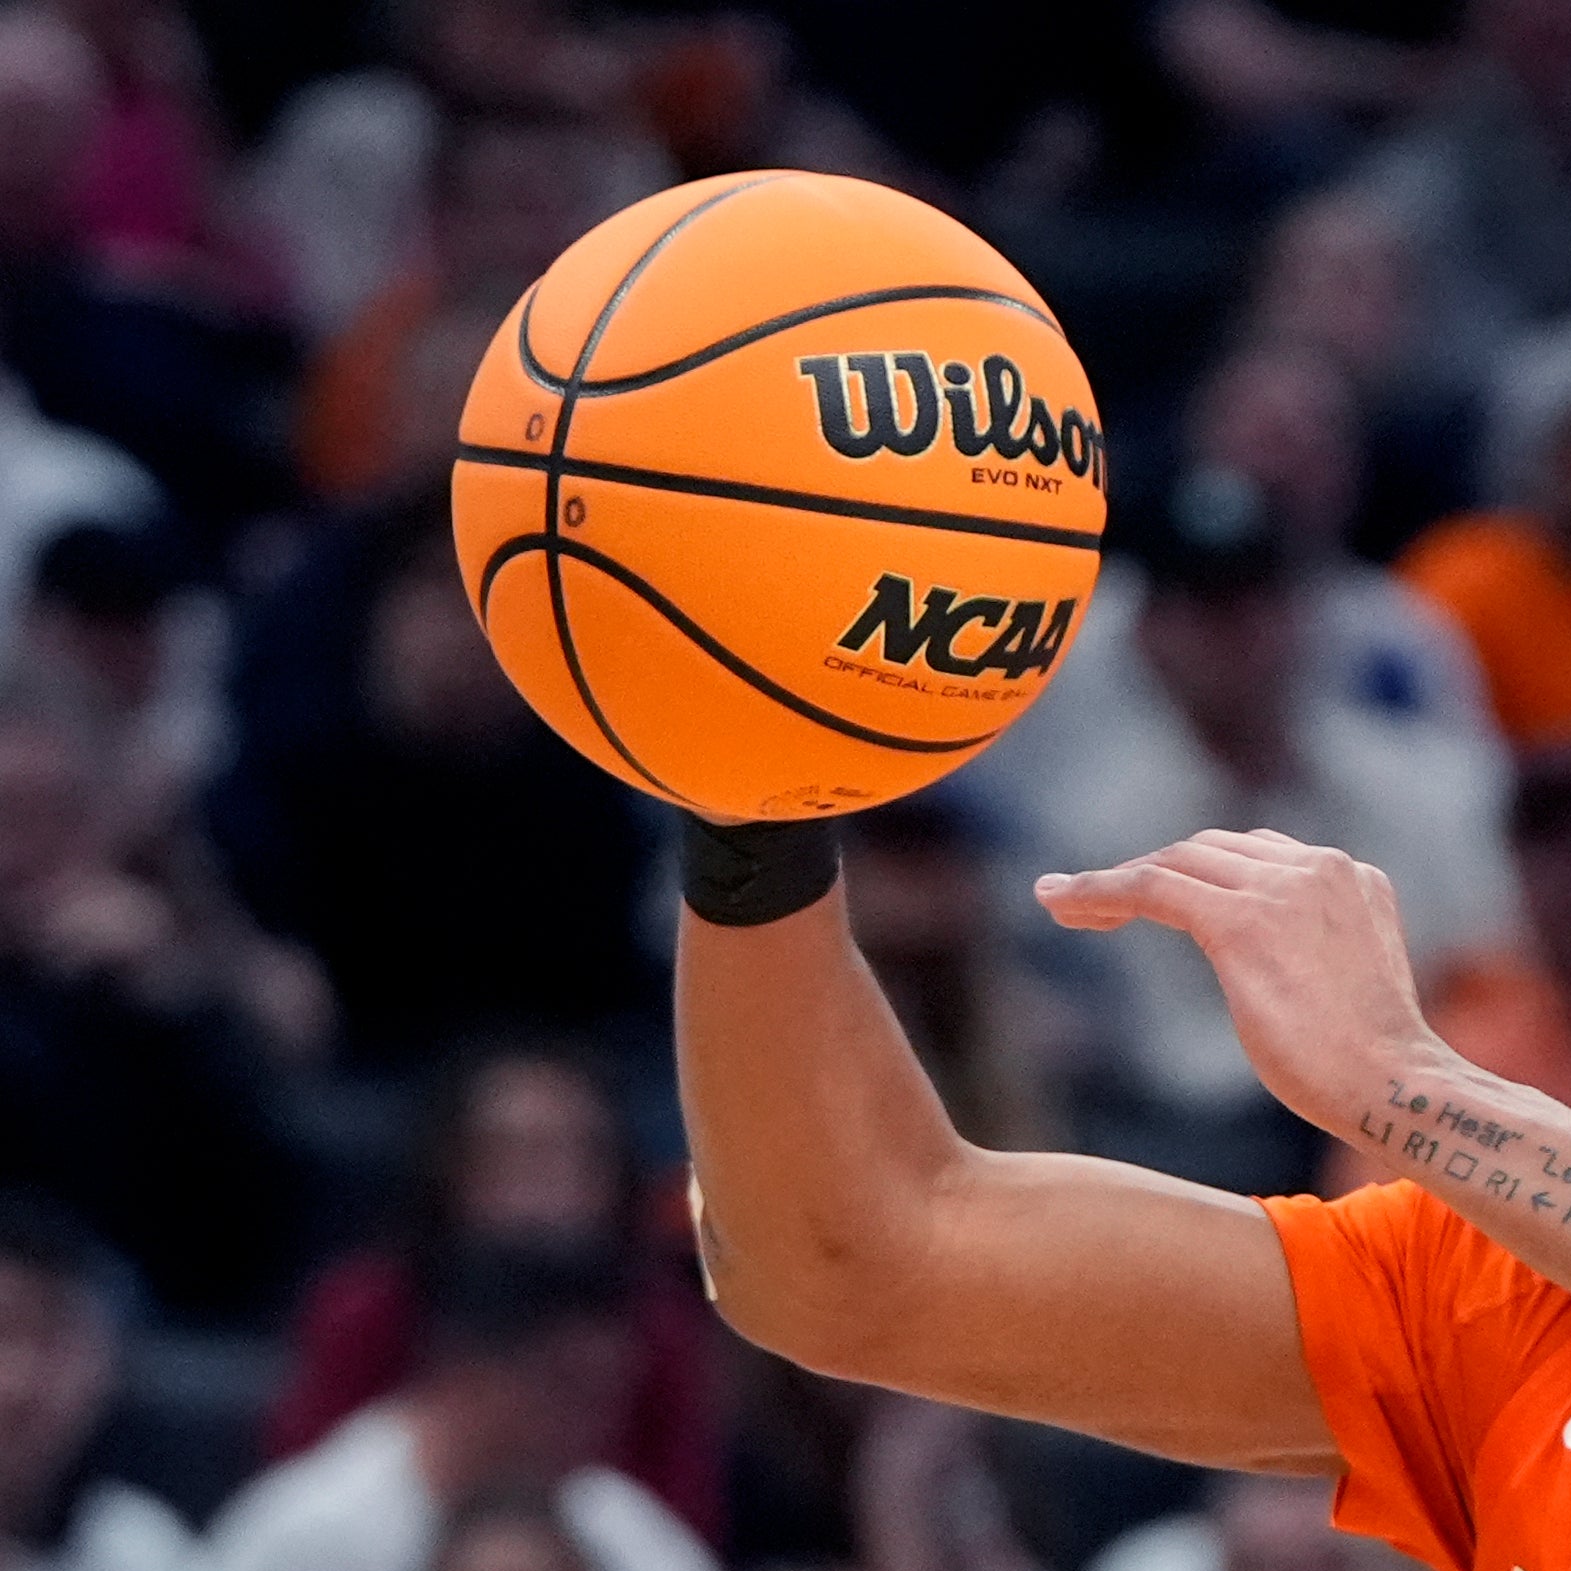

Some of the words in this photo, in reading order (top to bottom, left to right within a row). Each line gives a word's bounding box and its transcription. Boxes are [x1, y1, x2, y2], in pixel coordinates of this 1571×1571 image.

[972, 467, 1018, 487] EVO
[1026, 473, 1063, 495] NXT
[835, 570, 1077, 681] NCAA
[823, 655, 934, 696] OFFICIAL
[1402, 1130, 1440, 1164] R1
[1485, 1169, 1521, 1201] R1
